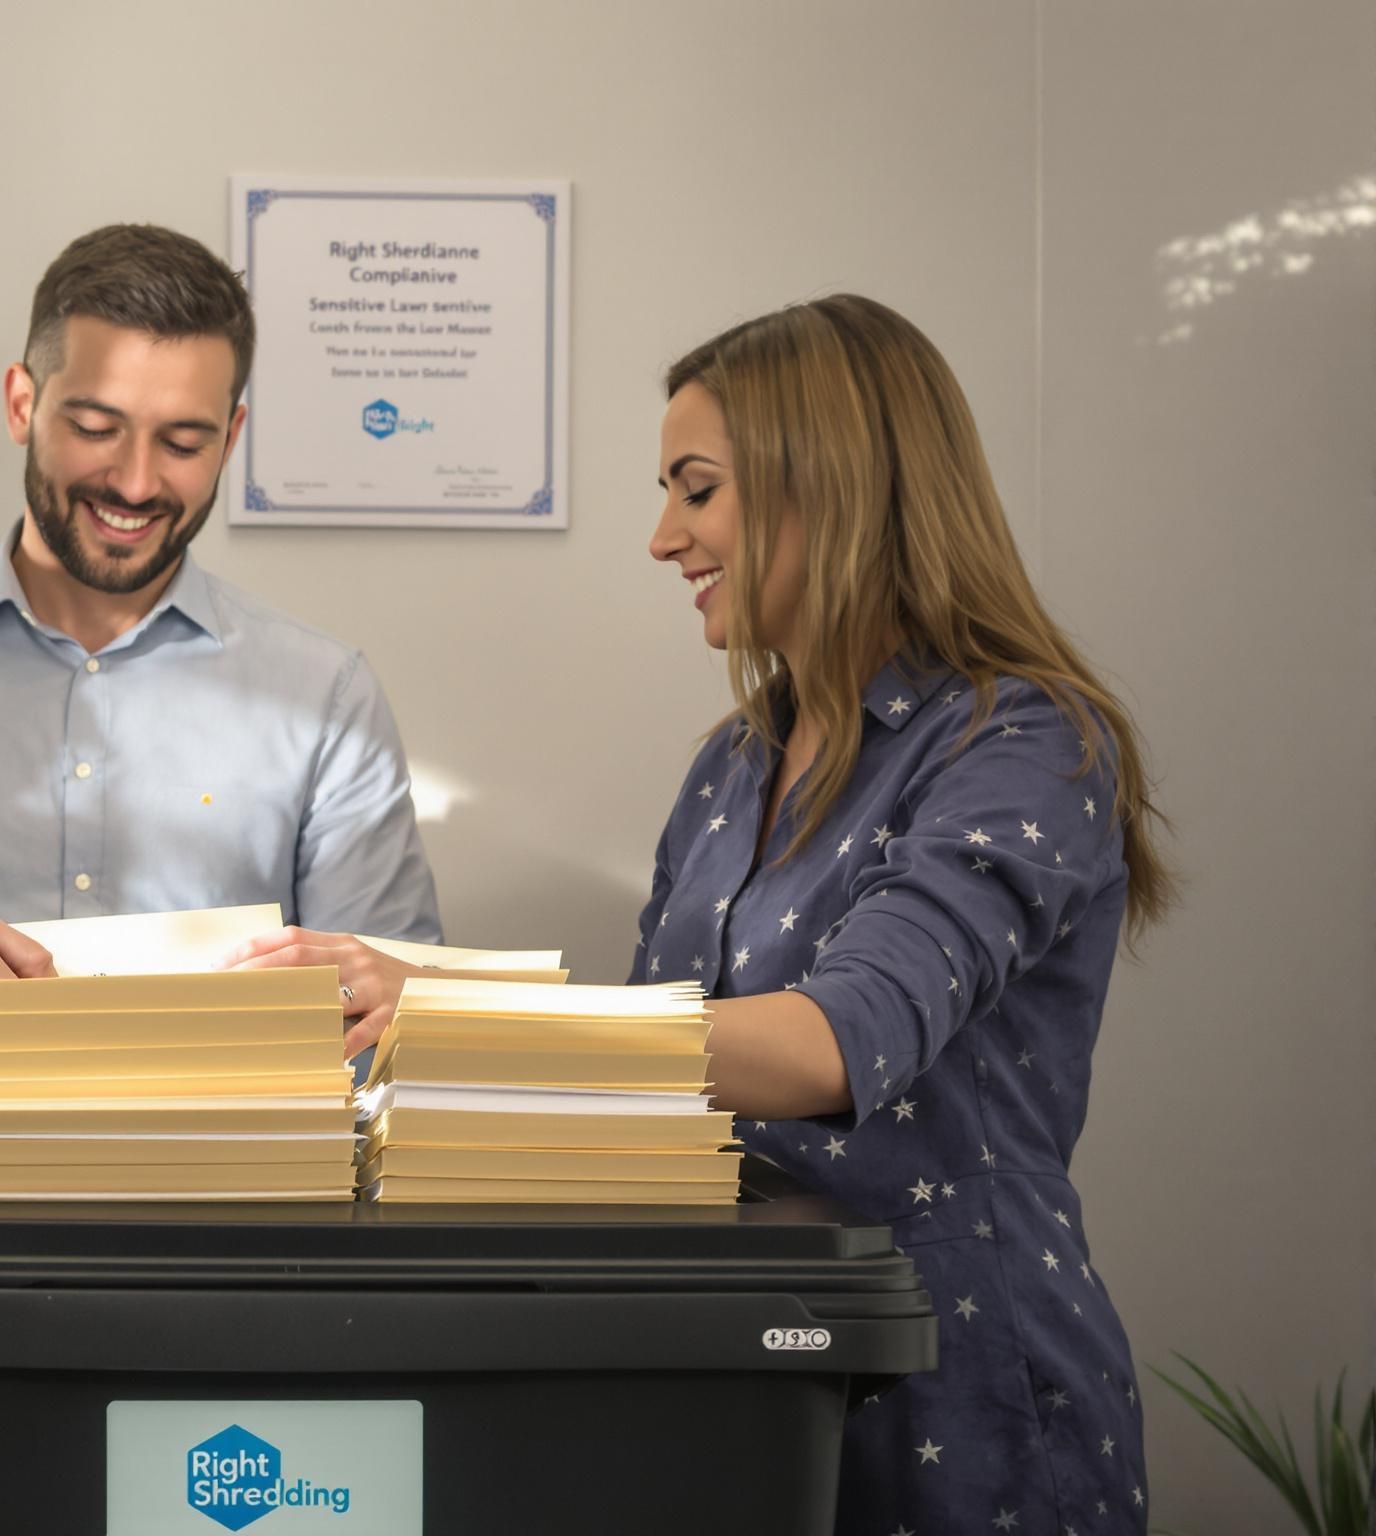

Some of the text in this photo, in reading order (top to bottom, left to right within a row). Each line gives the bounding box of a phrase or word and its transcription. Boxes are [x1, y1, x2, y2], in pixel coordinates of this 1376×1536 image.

[329, 241, 377, 262] Right
[309, 298, 386, 313] Sensitive
[192, 1449, 270, 1485] Right
[193, 1478, 350, 1513] Shredding
